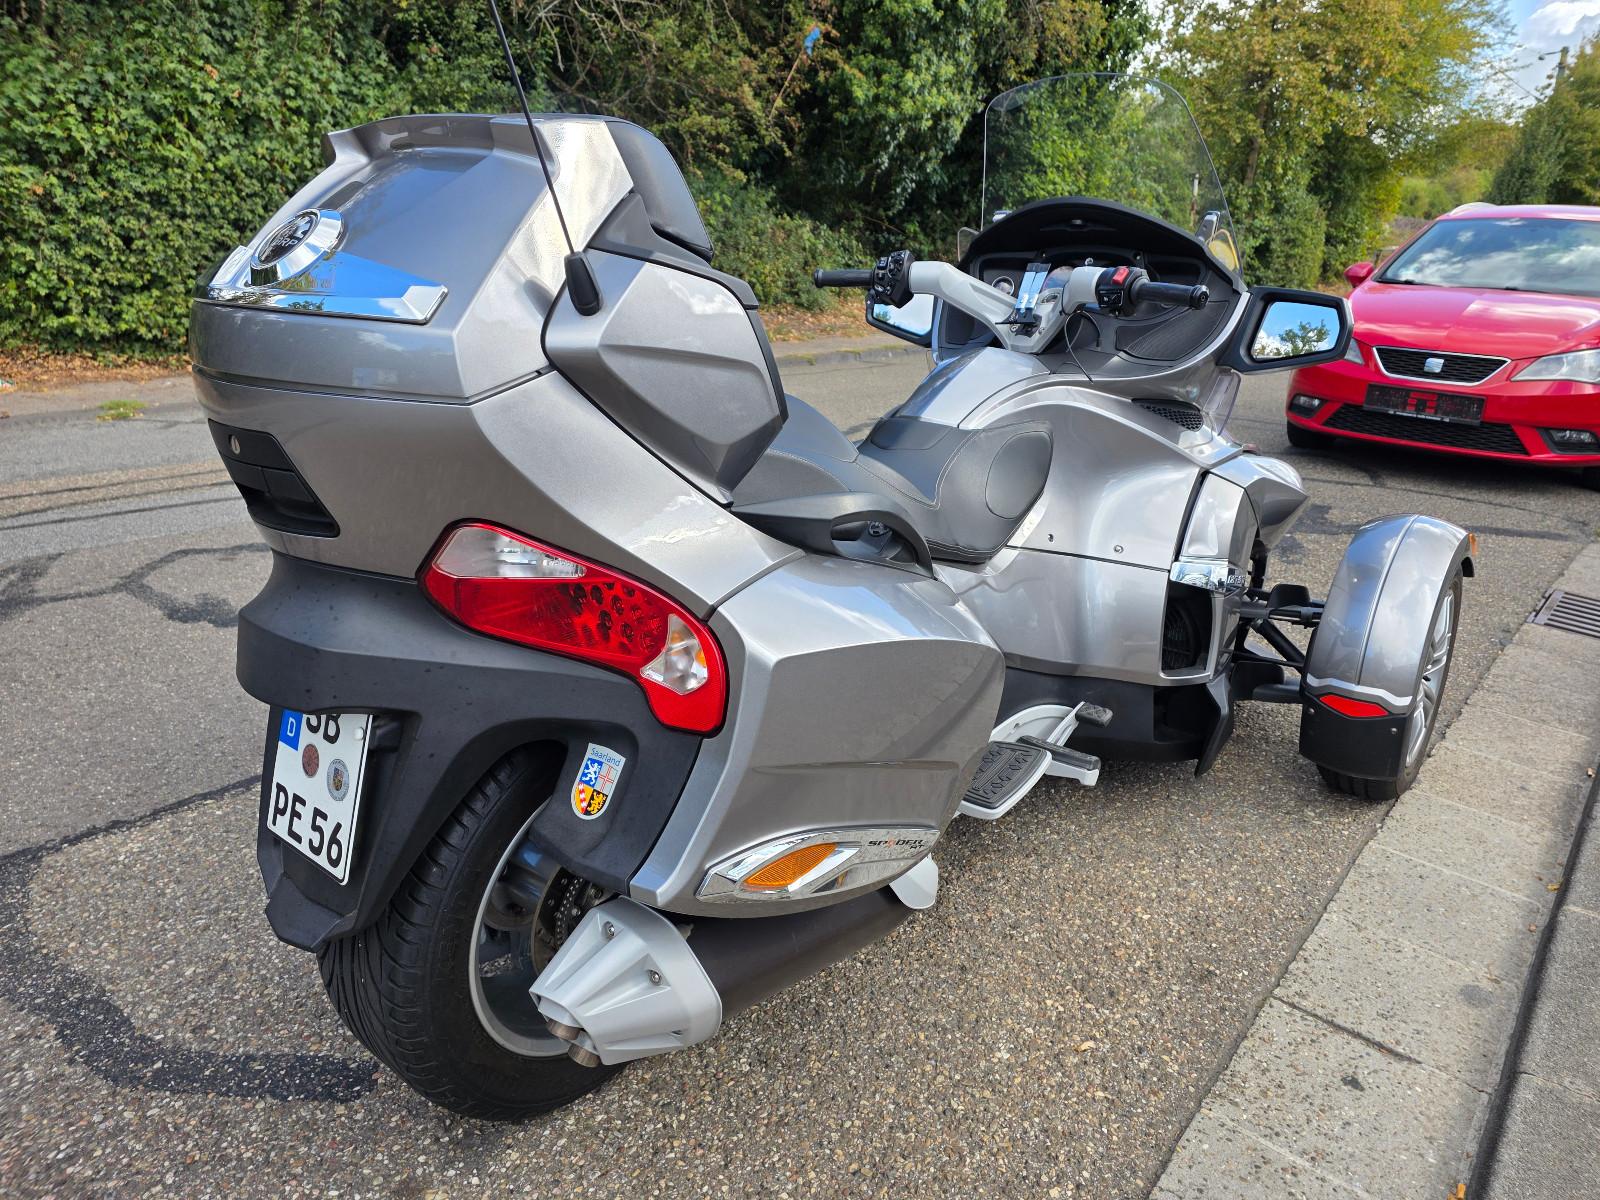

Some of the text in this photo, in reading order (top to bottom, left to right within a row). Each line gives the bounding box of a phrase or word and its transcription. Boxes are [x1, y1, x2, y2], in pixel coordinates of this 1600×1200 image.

[287, 716, 296, 737] D
[590, 747, 622, 767] Saarland
[271, 781, 343, 869] PE 56
